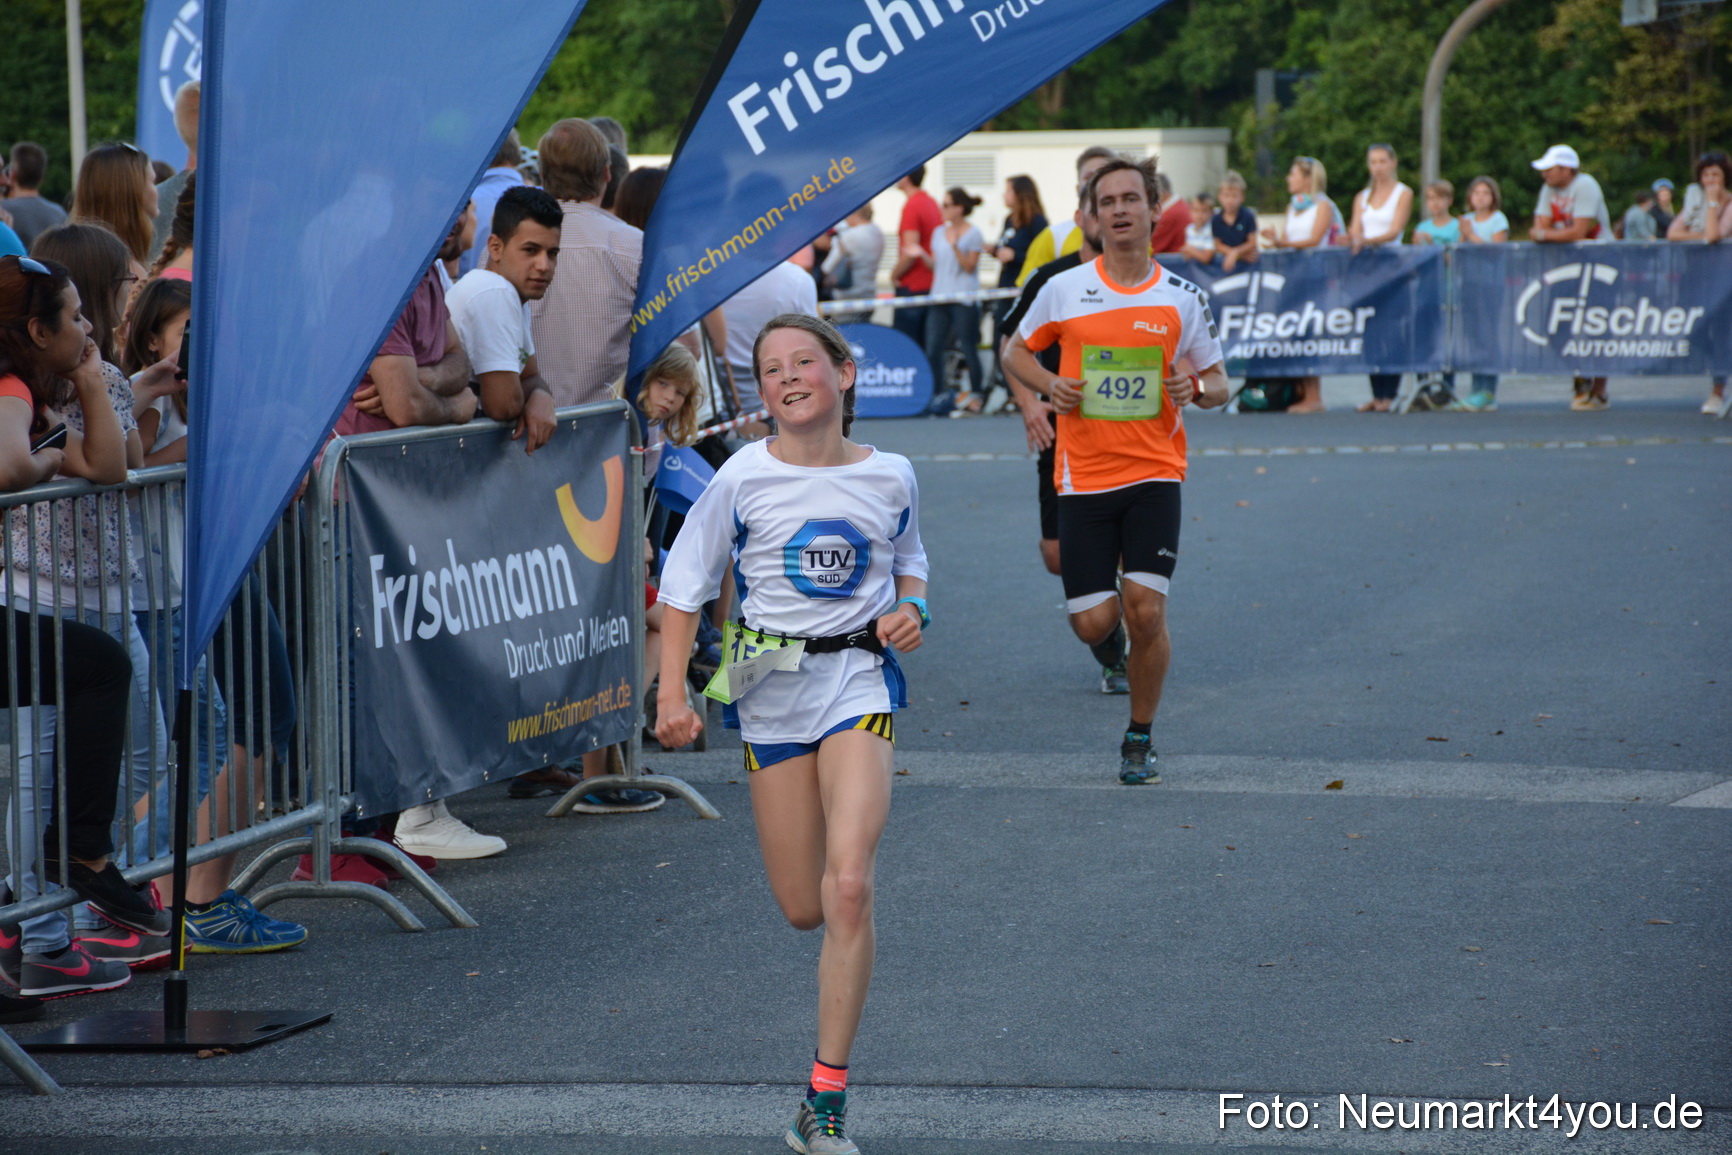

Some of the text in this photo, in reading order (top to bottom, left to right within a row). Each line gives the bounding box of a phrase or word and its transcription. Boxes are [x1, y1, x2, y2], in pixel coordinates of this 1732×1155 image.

[1219, 301, 1377, 342] Fischer
[1548, 297, 1705, 336] Fischer
[1227, 338, 1364, 360] AUTOMOBILE
[1562, 340, 1690, 358] AUTOMOBILE
[1097, 376, 1146, 400] 492
[805, 550, 851, 568] TÜV
[818, 574, 840, 584] SÜD
[370, 539, 578, 649] Frischmann
[503, 628, 552, 679] Druck
[553, 618, 585, 666] und
[731, 638, 774, 664] 15
